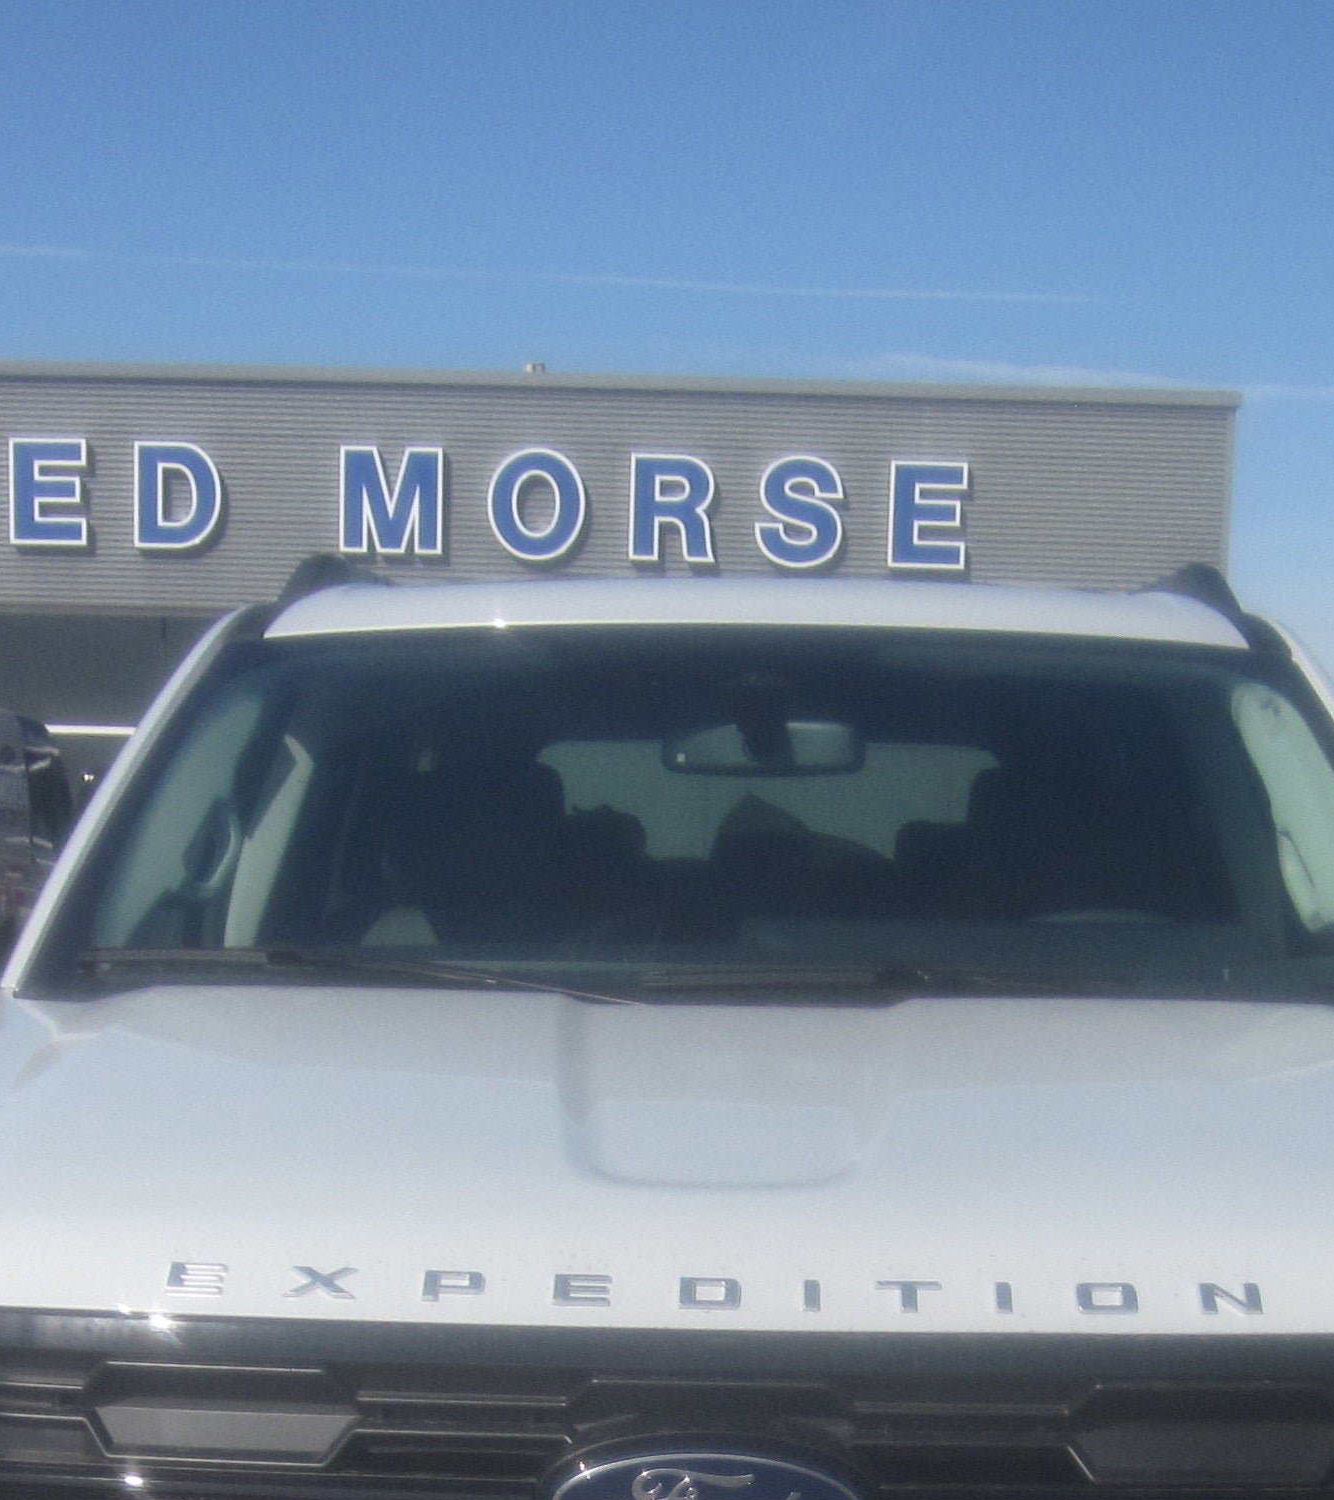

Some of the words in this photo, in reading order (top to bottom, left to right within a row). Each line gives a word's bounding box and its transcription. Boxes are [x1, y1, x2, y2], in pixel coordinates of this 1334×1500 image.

[7, 437, 222, 550] ED
[338, 446, 969, 571] MORSE
[164, 1260, 1263, 1316] EXPEDITION
